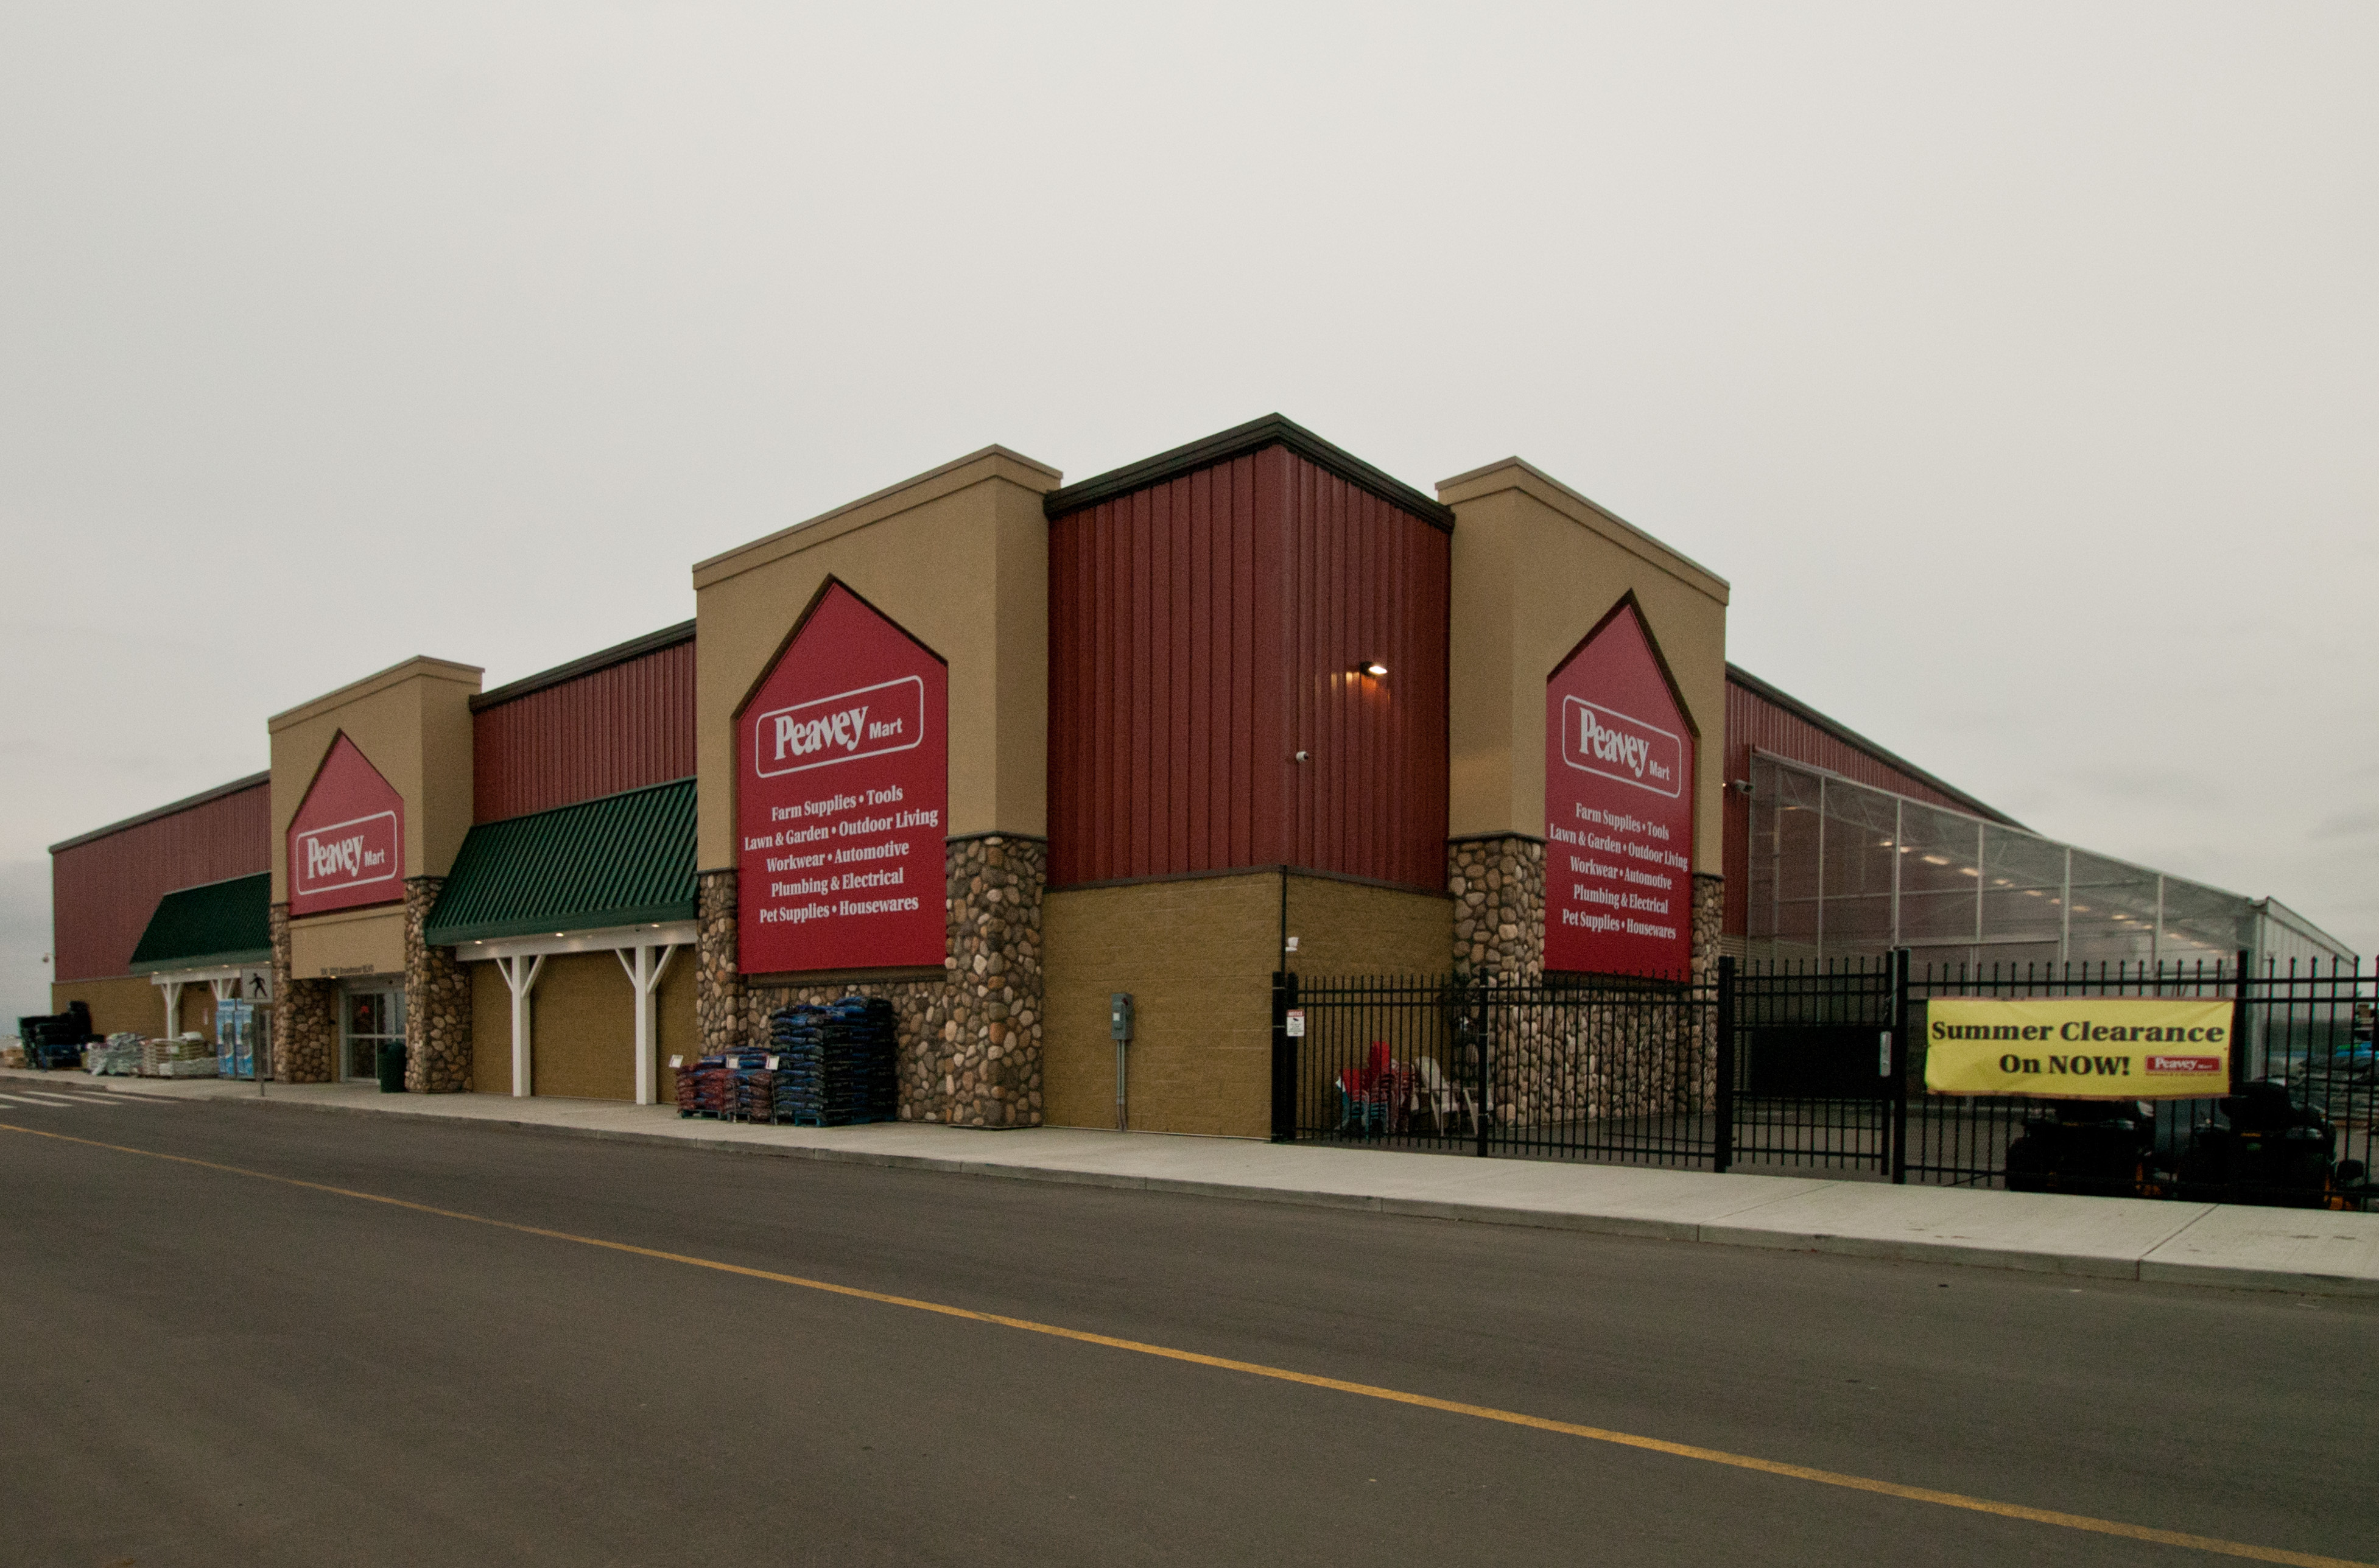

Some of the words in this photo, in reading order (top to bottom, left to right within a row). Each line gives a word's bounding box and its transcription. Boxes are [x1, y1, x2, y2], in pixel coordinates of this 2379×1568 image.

[774, 706, 869, 761] Peavey
[870, 717, 902, 739] Mart
[1580, 707, 1650, 778] Peavey
[1650, 760, 1670, 781] Mart
[771, 804, 802, 821] Farm
[804, 793, 856, 817] Supplies
[866, 784, 903, 806] Tools
[745, 834, 773, 851] Lawn
[775, 832, 784, 846] &
[786, 825, 829, 845] Garden
[839, 815, 893, 837] Outdoor
[896, 808, 939, 829] Living
[1576, 802, 1601, 823] Farm
[1603, 809, 1641, 832] Supplies
[1647, 821, 1669, 841] Tools
[307, 835, 364, 879] Peavey
[365, 848, 385, 867] Mart
[767, 853, 826, 873] Workwear
[834, 840, 910, 864] Automotive
[1550, 823, 1576, 844] Lawn
[1578, 831, 1586, 846] &
[1588, 832, 1622, 854] Garden
[1628, 842, 1663, 864] Outdoor
[1664, 851, 1688, 873] Living
[771, 877, 828, 898] Plumbing
[831, 876, 840, 890] &
[842, 867, 904, 890] Electrical
[1570, 856, 1618, 879] Workwear
[1625, 867, 1672, 890] Automotive
[760, 908, 778, 923] Pet
[779, 902, 829, 924] Supplies
[840, 896, 919, 916] Housewares
[1573, 884, 1620, 909] Plumbing
[1621, 892, 1628, 907] &
[1629, 893, 1668, 914] Electrical
[1562, 909, 1578, 926] Pet
[1580, 911, 1620, 933] Supplies
[1626, 918, 1676, 940] Housewares
[1931, 1021, 2054, 1041] Summer
[2060, 1021, 2225, 1043] Clearance
[1999, 1053, 2042, 1074] On
[2048, 1055, 2131, 1075] NOW!
[2154, 1056, 2198, 1071] Peavey
